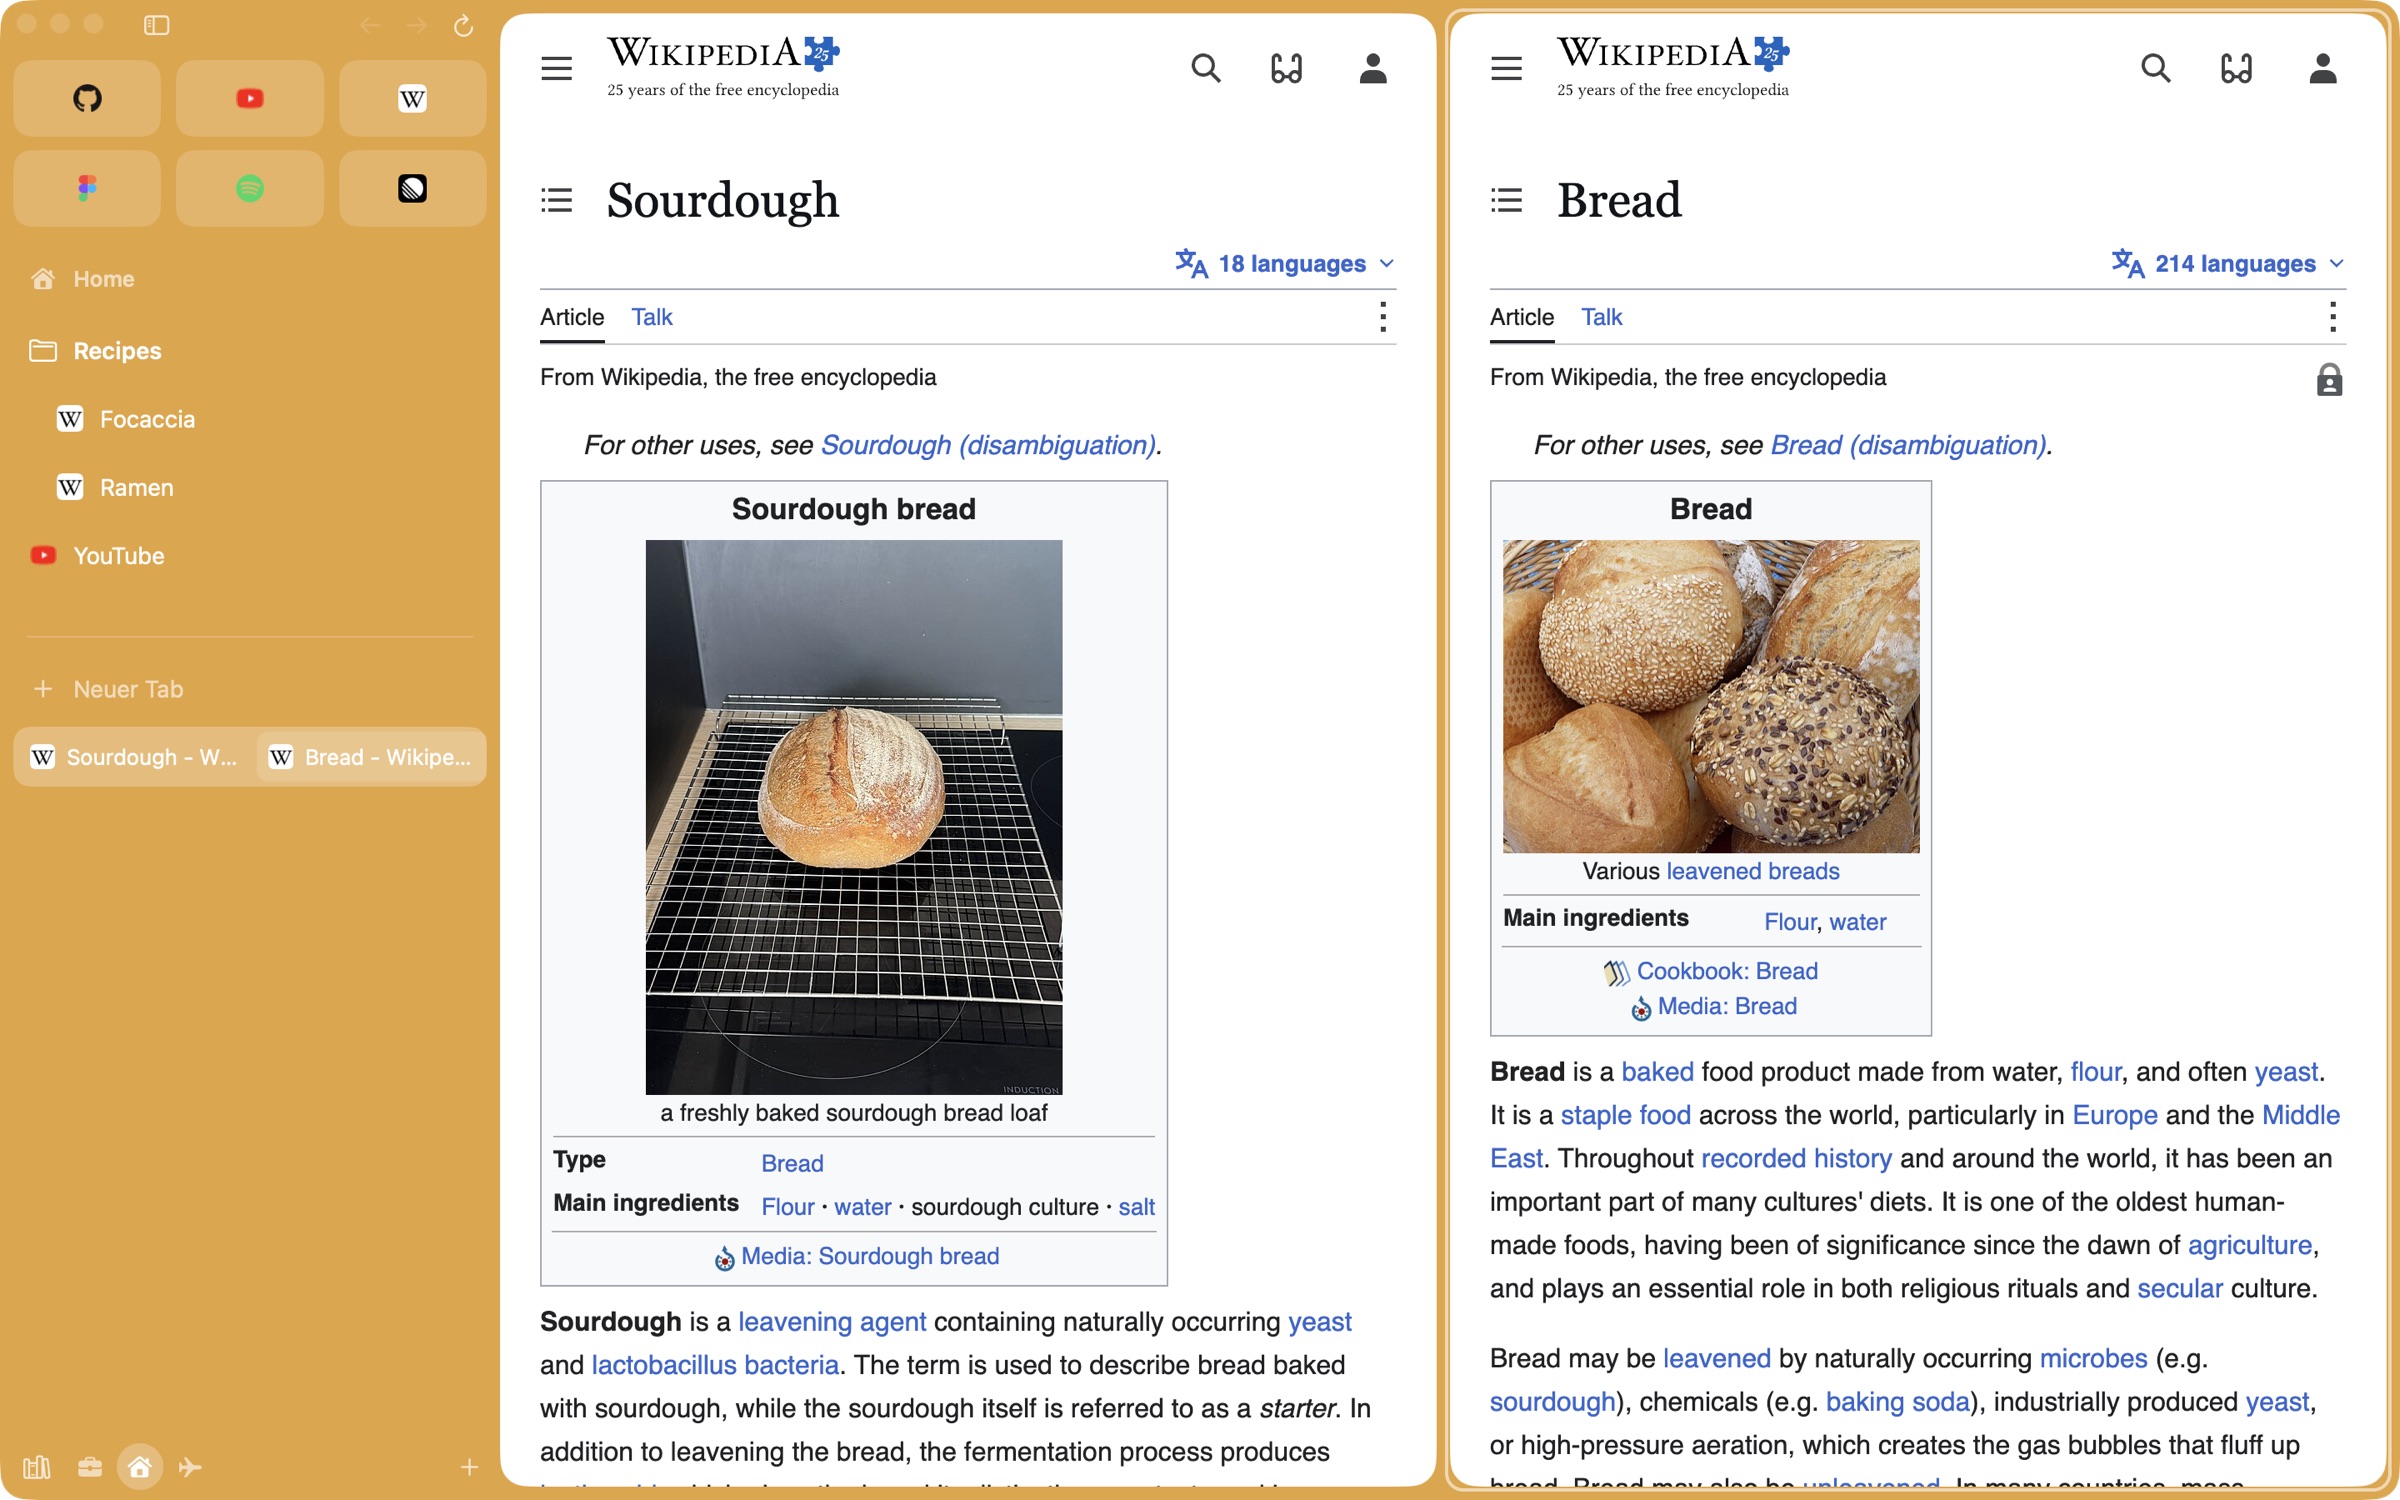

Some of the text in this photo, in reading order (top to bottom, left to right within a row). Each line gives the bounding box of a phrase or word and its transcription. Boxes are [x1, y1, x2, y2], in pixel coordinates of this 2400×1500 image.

[813, 46, 830, 62] 25
[1763, 46, 1780, 62] 25
[607, 82, 840, 100] 25 years of the free encyclopedia
[1557, 82, 1790, 100] 25 years of the free encyclopedia
[607, 179, 841, 229] Sourdough
[1557, 179, 1683, 219] Bread
[1219, 253, 1367, 278] 18 languages
[2155, 253, 2317, 278] 214 languages
[73, 270, 136, 289] Home
[539, 307, 605, 327] Article
[631, 307, 674, 327] Talk
[1489, 307, 1555, 327] Article
[1581, 307, 1624, 327] Talk
[74, 340, 163, 365] Recipes
[541, 367, 938, 391] From Wikipedia, the free encyclopedia
[1491, 367, 1888, 391] From Wikipedia, the free encyclopedia
[100, 408, 196, 429] Focaccia
[584, 433, 1162, 461] For other uses, see Sourdough (disambiguation).
[1534, 433, 2052, 461] For other uses, see Bread (disambiguation).
[100, 477, 174, 497] Ramen
[732, 496, 976, 527] Sourdough bread
[1671, 497, 1753, 521] Bread
[73, 545, 165, 566] YouTube
[74, 679, 185, 699] Neuer Tab
[66, 747, 178, 770] Sourdough
[305, 747, 364, 767] Bread
[1582, 861, 1841, 881] Various leavened breads
[1503, 907, 1690, 932] Main ingredients
[1765, 911, 1888, 934] Flour, water
[1637, 961, 1819, 981] Cookbook: Bread
[1658, 996, 1798, 1016] Media: Bread
[1491, 1060, 2325, 1088] Bread is a baked food product made from water, flour, and often yeast.
[1002, 1085, 1061, 1096] INDUCTION
[660, 1102, 1049, 1127] a freshly baked sourdough bread loaf
[552, 1149, 607, 1174] Type
[762, 1153, 824, 1173] Bread
[554, 1192, 740, 1217] Main ingredients
[762, 1196, 1156, 1221] Flour water sourdough culture salt
[742, 1245, 1000, 1270] Media: Sourdough bread
[1490, 1233, 2319, 1261] made foods, having been of significance since the dawn of agriculture,
[540, 1310, 1353, 1338] Sourdough is a leavening agent containing naturally occurring yeast
[540, 1353, 1345, 1376] and lactobacillus bacteria. The term is used to describe bread baked
[1491, 1346, 2208, 1374] Bread may be leavened by naturally occurring microbes (e.g.
